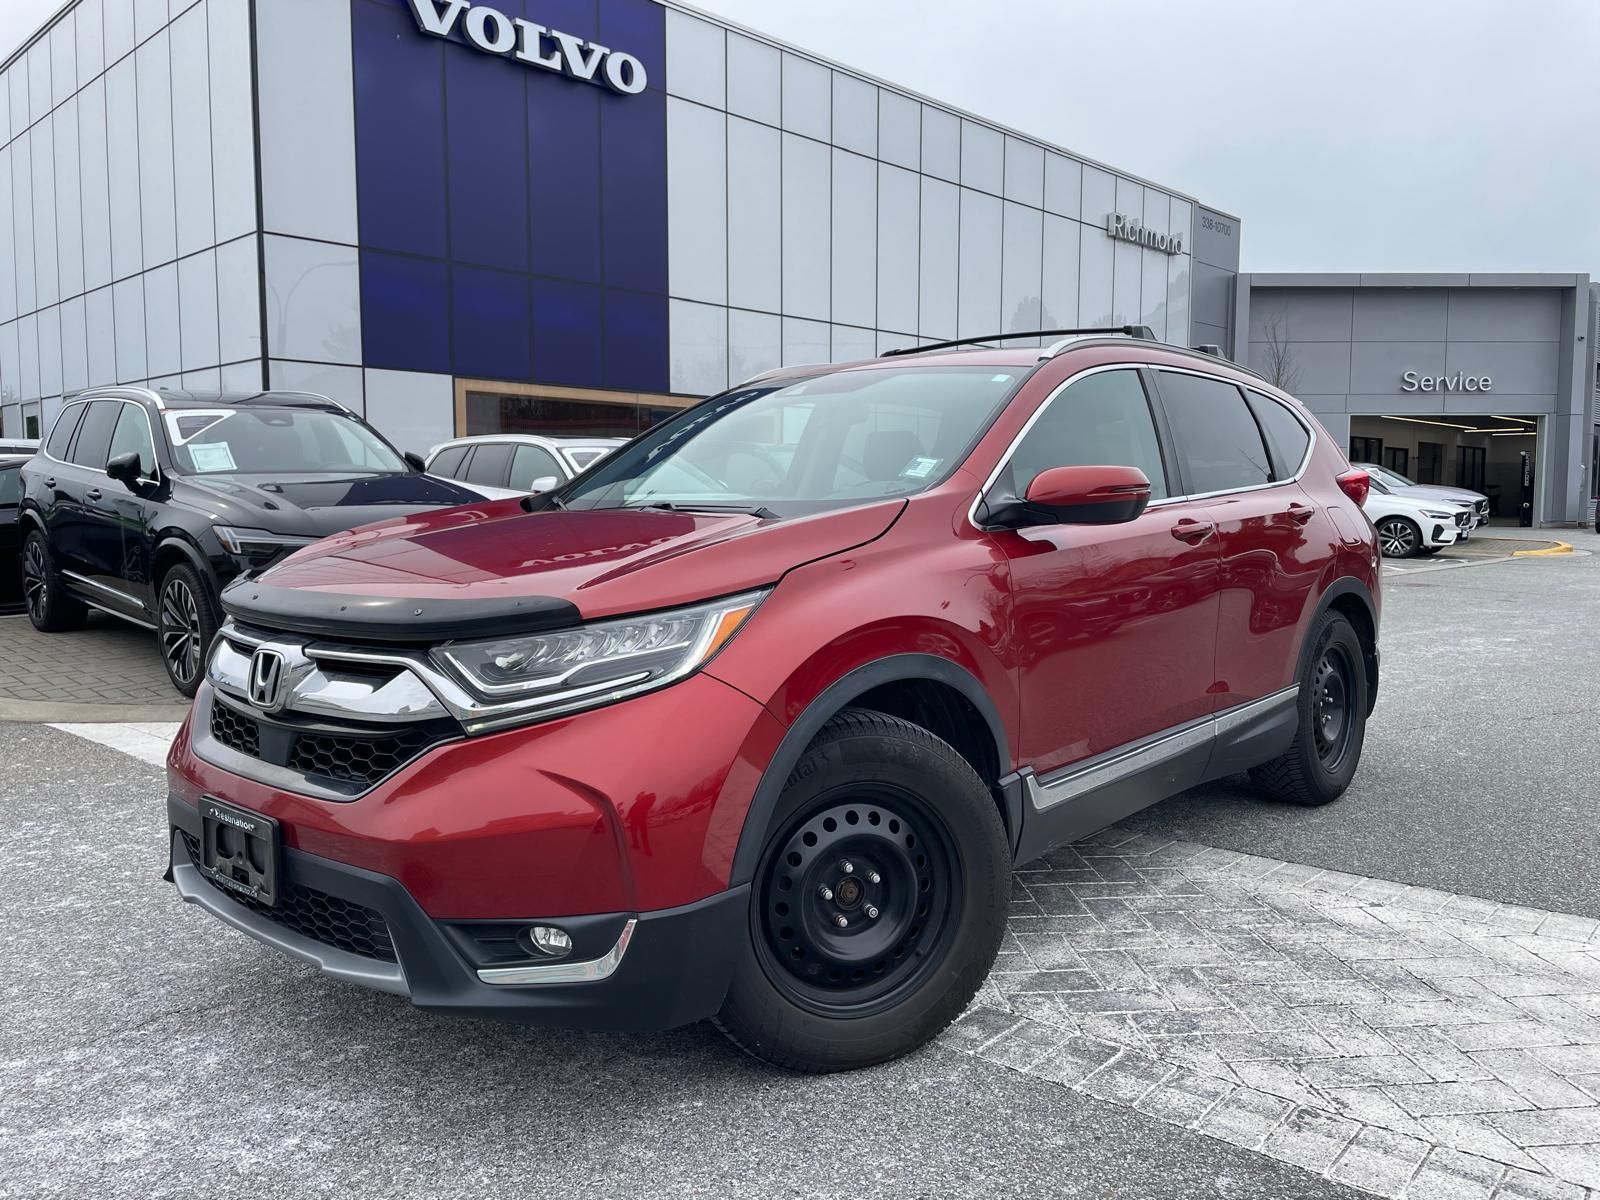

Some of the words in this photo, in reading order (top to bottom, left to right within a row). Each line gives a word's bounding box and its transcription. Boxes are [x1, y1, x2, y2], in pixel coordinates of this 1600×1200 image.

[408, 0, 648, 94] VOLVO
[1108, 211, 1184, 255] Richmond
[1402, 371, 1492, 391] Service
